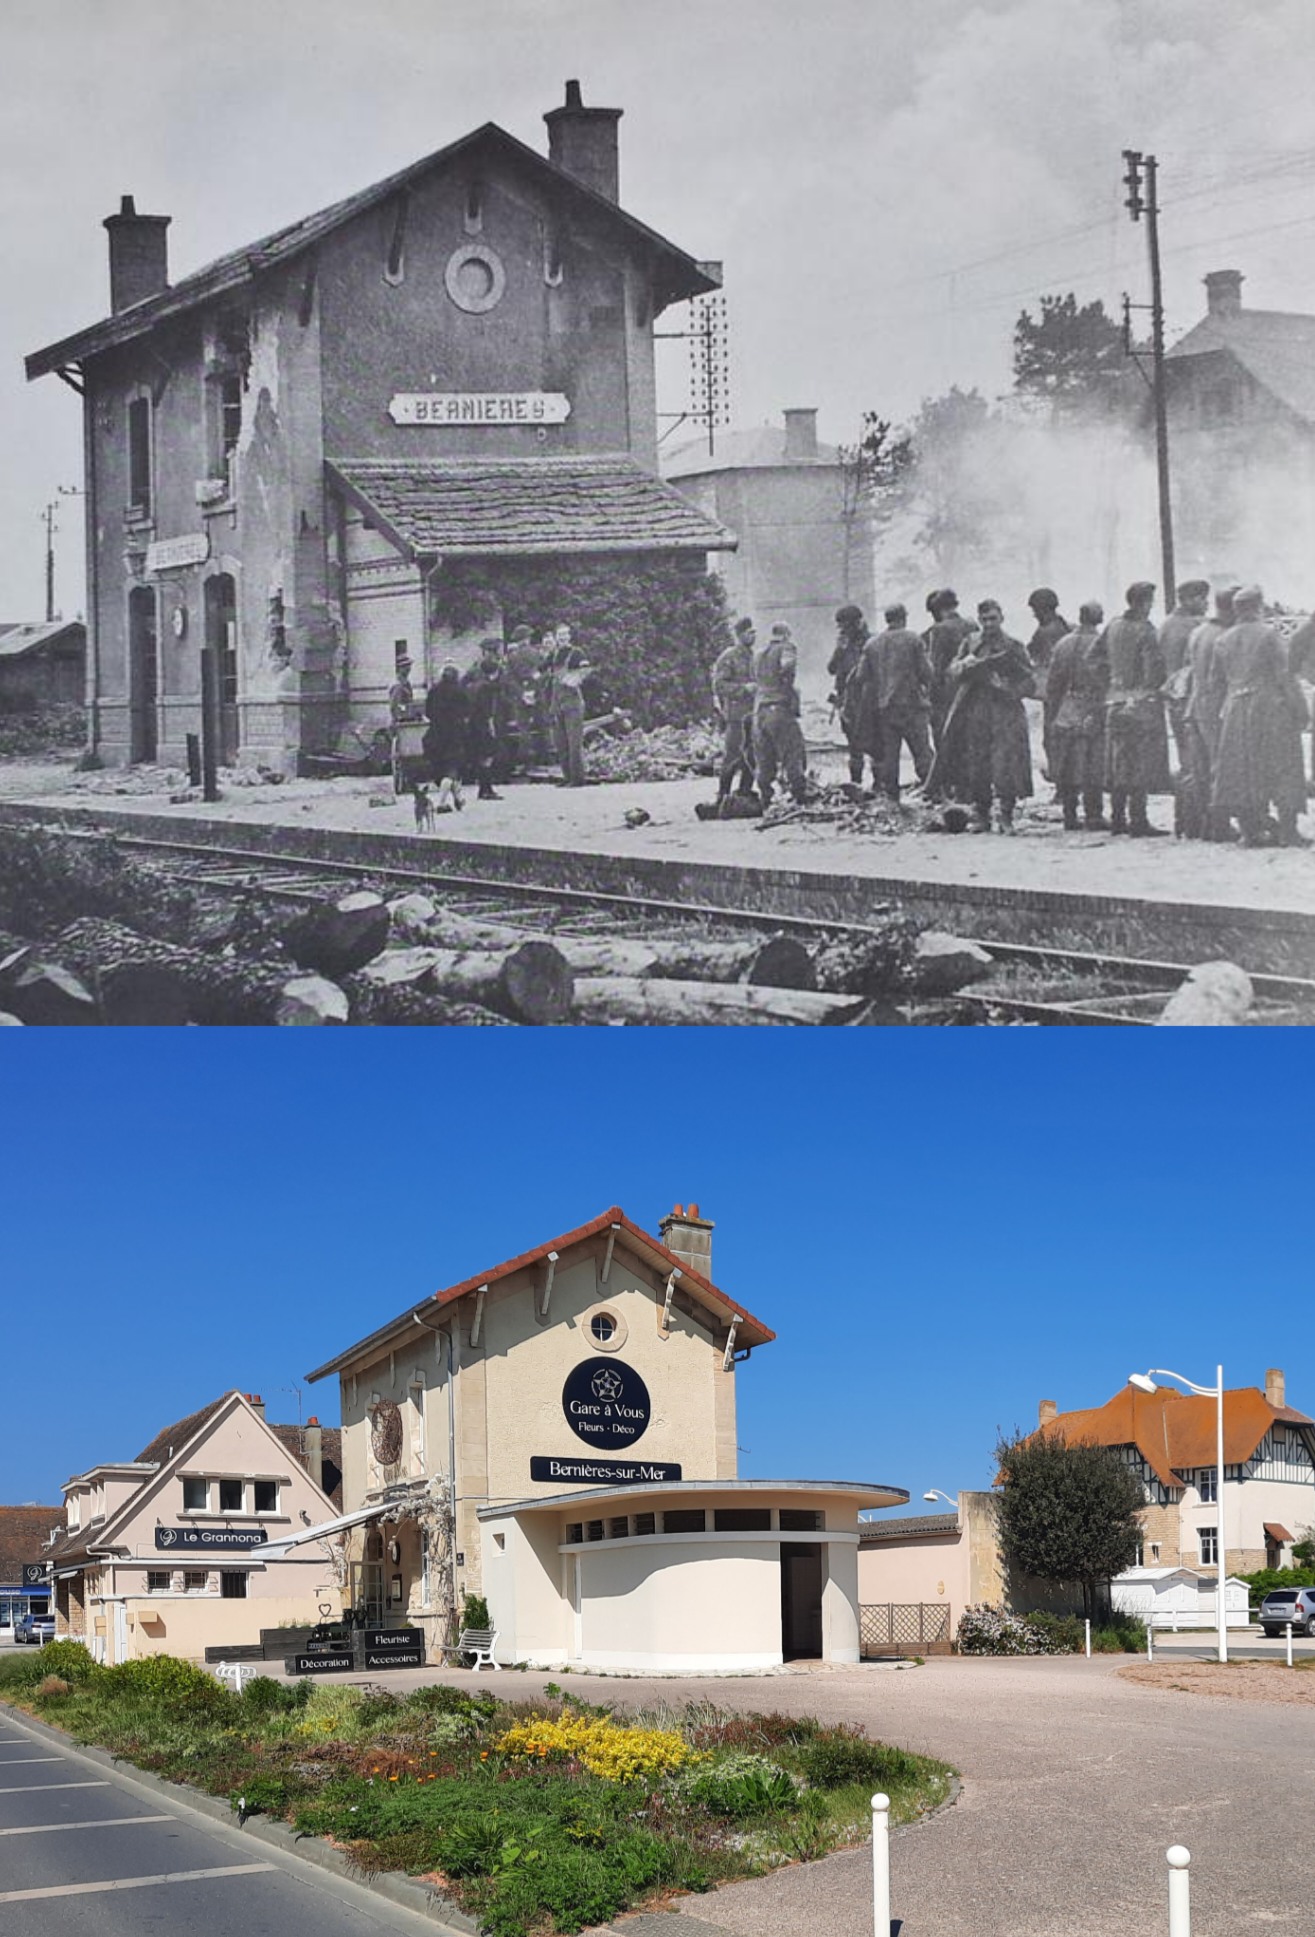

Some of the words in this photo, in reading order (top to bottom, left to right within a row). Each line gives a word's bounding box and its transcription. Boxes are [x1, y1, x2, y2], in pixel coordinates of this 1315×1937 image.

[570, 1400, 600, 1415] Gare
[604, 1404, 611, 1416] à
[614, 1403, 645, 1418] Vous
[578, 1421, 604, 1432] Fleurs
[612, 1423, 634, 1434] Déco
[550, 1461, 665, 1480] Bernières-sur-Mer
[184, 1532, 197, 1542] Le
[201, 1532, 261, 1543] Grannona
[375, 1635, 410, 1645] Fleuriste
[300, 1658, 349, 1669] Décoration
[369, 1654, 418, 1665] Accessoires
